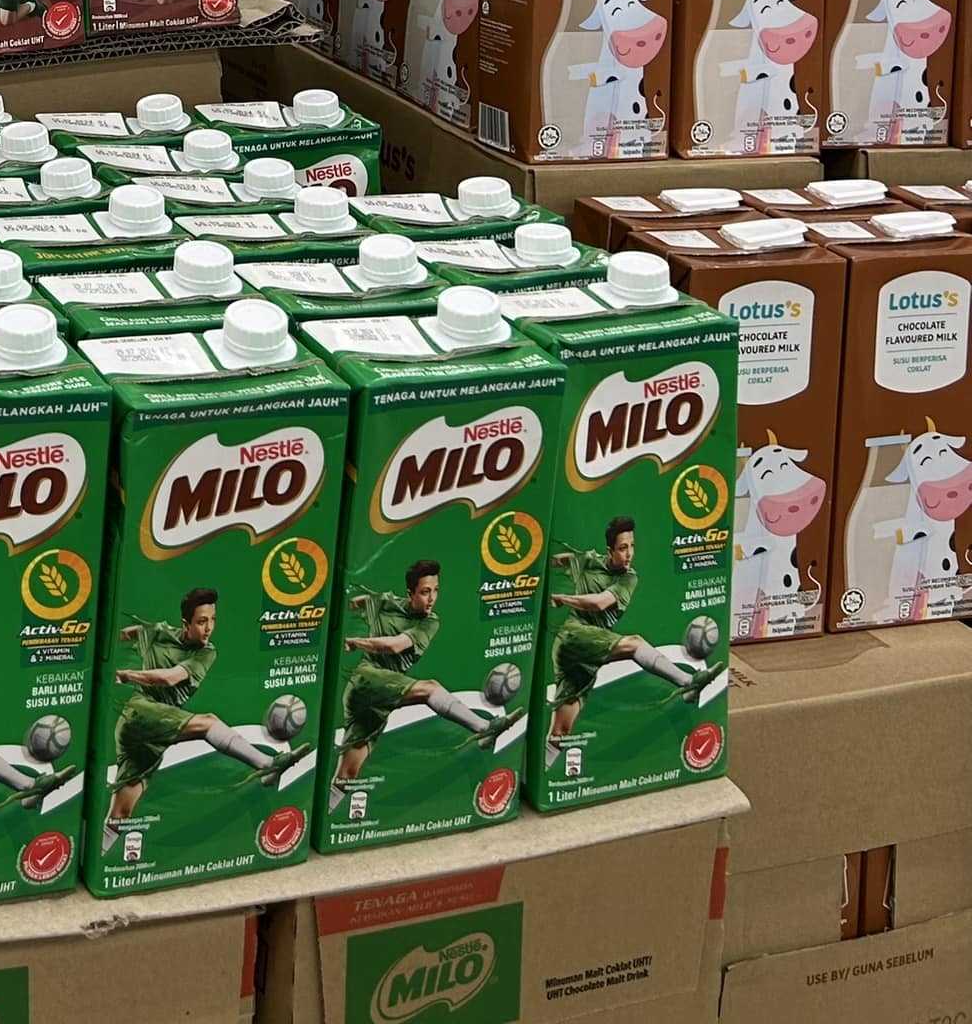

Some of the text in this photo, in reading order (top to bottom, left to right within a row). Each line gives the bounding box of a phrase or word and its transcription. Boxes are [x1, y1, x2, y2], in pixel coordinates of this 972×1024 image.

[729, 300, 801, 321] Lotus's
[889, 290, 959, 311] Lotus's
[739, 331, 788, 343] CHOCOLATE
[885, 332, 958, 346] FLAVOURED MILK
[898, 320, 946, 332] CHOCOLATE
[738, 343, 801, 356] VOURED MILK
[585, 396, 705, 464] MILO
[391, 436, 527, 508] MILO
[163, 459, 308, 532] MILO
[555, 789, 577, 803] Liter
[582, 783, 617, 798] Minuman
[619, 779, 637, 793] Malt
[638, 774, 663, 789] Coklat
[663, 770, 681, 784] UHT
[354, 889, 418, 912] TENAGA
[387, 953, 484, 1009] MILO
[546, 973, 584, 990] Minuman
[585, 967, 604, 981] Malt
[605, 961, 632, 976] Coklat
[806, 971, 828, 987] USE
[852, 960, 884, 977] GUNA
[886, 947, 935, 970] SEBELUM
[546, 968, 650, 1001] UHT Chocolate Malt Drink
